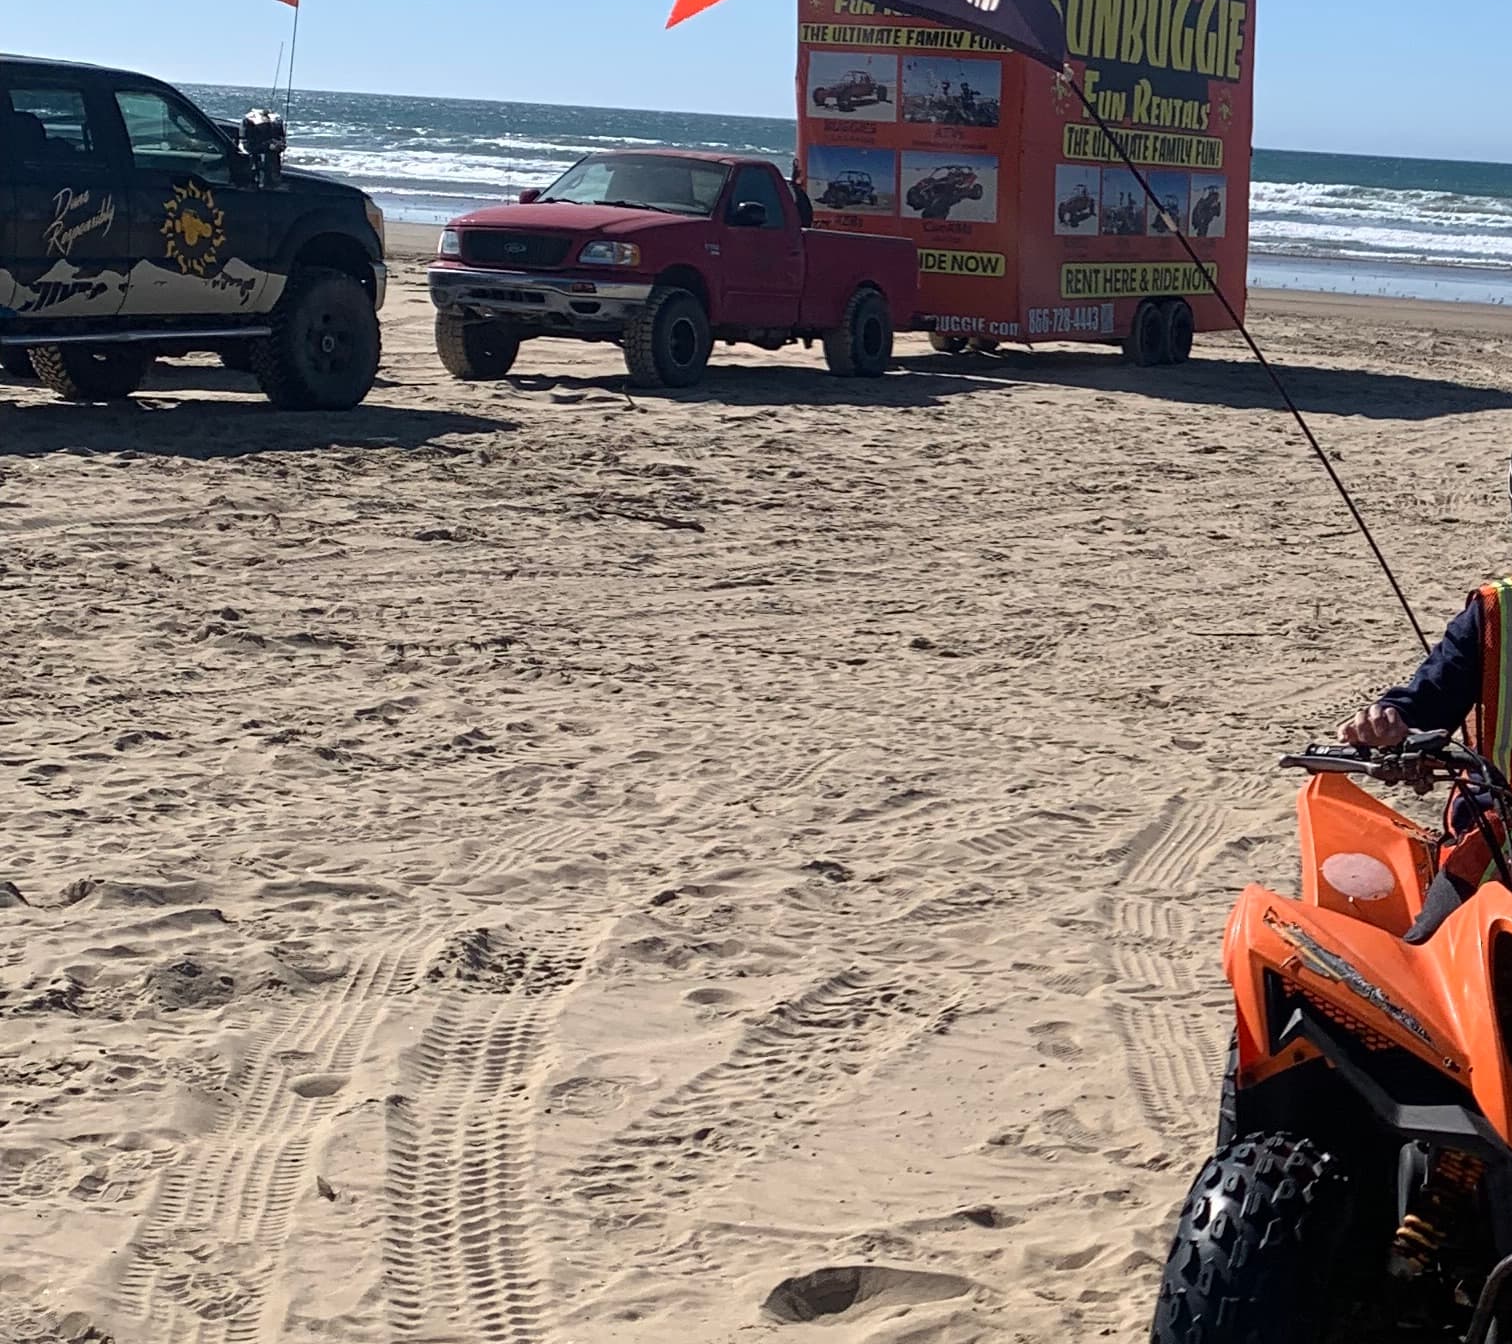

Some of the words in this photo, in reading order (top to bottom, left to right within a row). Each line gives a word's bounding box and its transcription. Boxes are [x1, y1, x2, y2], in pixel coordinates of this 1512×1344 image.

[803, 24, 829, 41] THE
[832, 26, 902, 45] ULTIMATE
[907, 29, 965, 47] FAMILY
[970, 32, 1008, 51] FUN
[1067, 126, 1089, 156] THE
[1151, 135, 1193, 164] FAMILY
[1196, 139, 1221, 166] FUN!
[920, 253, 948, 270] IDE
[951, 255, 1000, 274] NOW
[1065, 268, 1100, 294] RENT
[1103, 267, 1137, 293] HERE
[1139, 268, 1149, 291] &
[1151, 266, 1180, 291] RIDE
[1182, 266, 1216, 291] NOW
[1028, 307, 1099, 334] 866-728-4443
